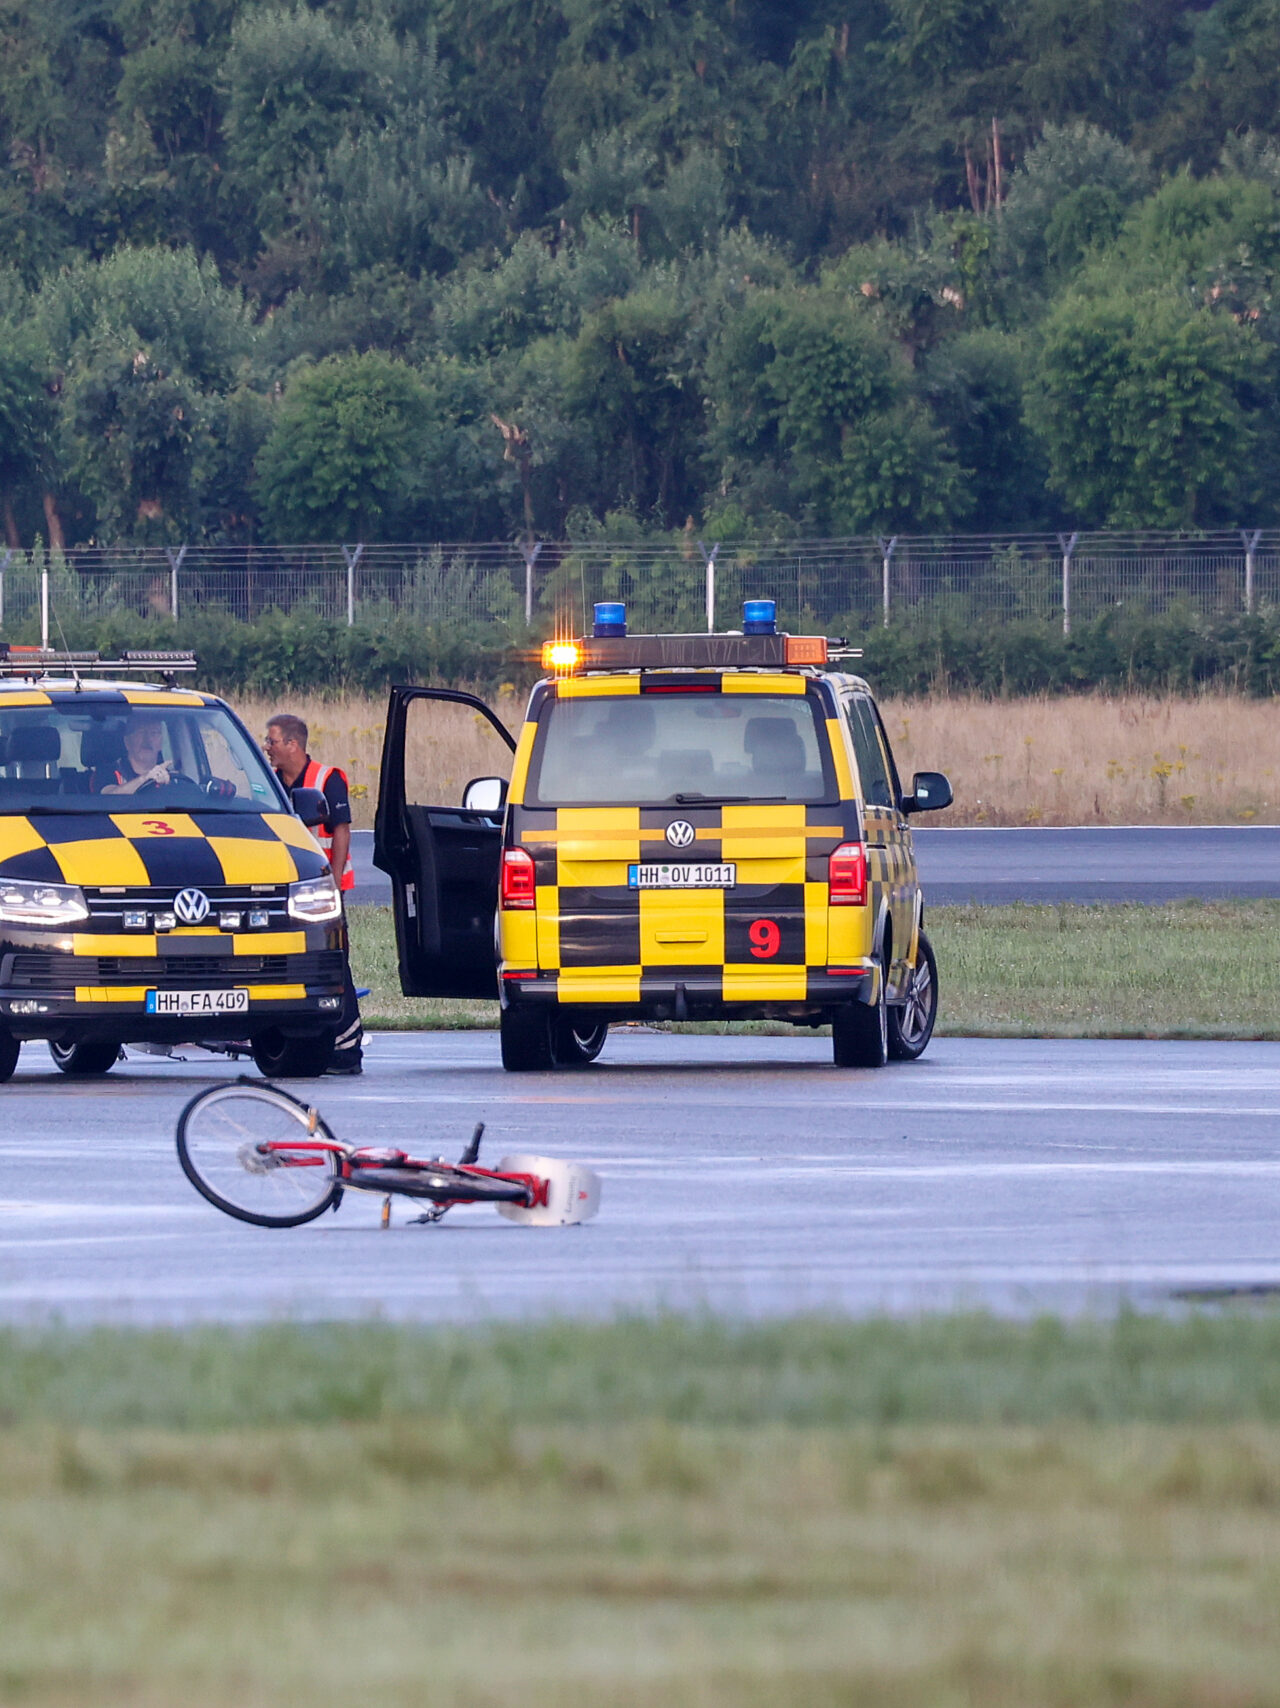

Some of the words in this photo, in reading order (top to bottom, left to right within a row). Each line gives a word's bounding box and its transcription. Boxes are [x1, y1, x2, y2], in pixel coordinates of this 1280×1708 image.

[142, 821, 176, 835] 3
[639, 867, 659, 883] HH
[671, 867, 691, 883] OV
[695, 866, 732, 883] 1011
[749, 919, 781, 958] 9
[158, 994, 180, 1011] HH
[191, 993, 212, 1010] FA
[215, 992, 245, 1010] 409
